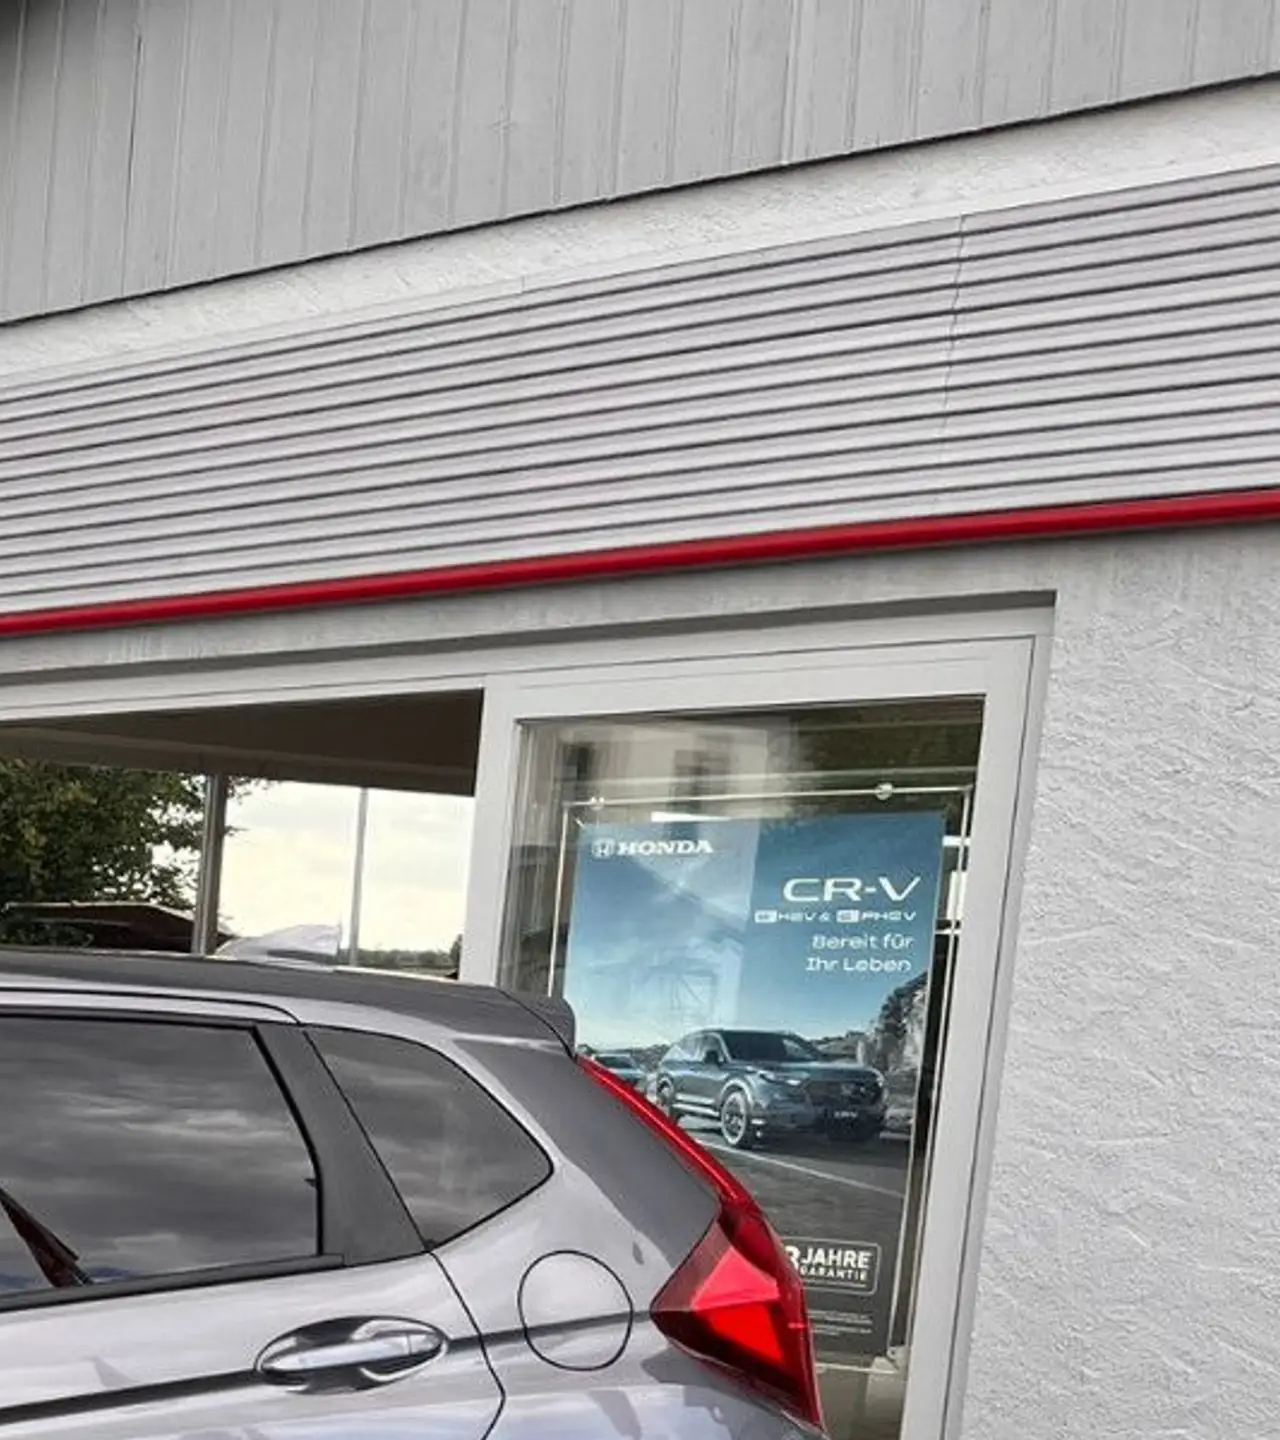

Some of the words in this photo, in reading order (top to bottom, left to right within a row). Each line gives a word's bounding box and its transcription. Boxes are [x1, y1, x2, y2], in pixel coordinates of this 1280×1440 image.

[617, 839, 714, 855] HONDA
[783, 876, 921, 902] CR-V
[812, 933, 878, 949] Bereit
[883, 933, 915, 949] für
[805, 957, 838, 971] Ihr
[843, 957, 912, 972] Leben
[801, 1247, 873, 1269] JAHRE
